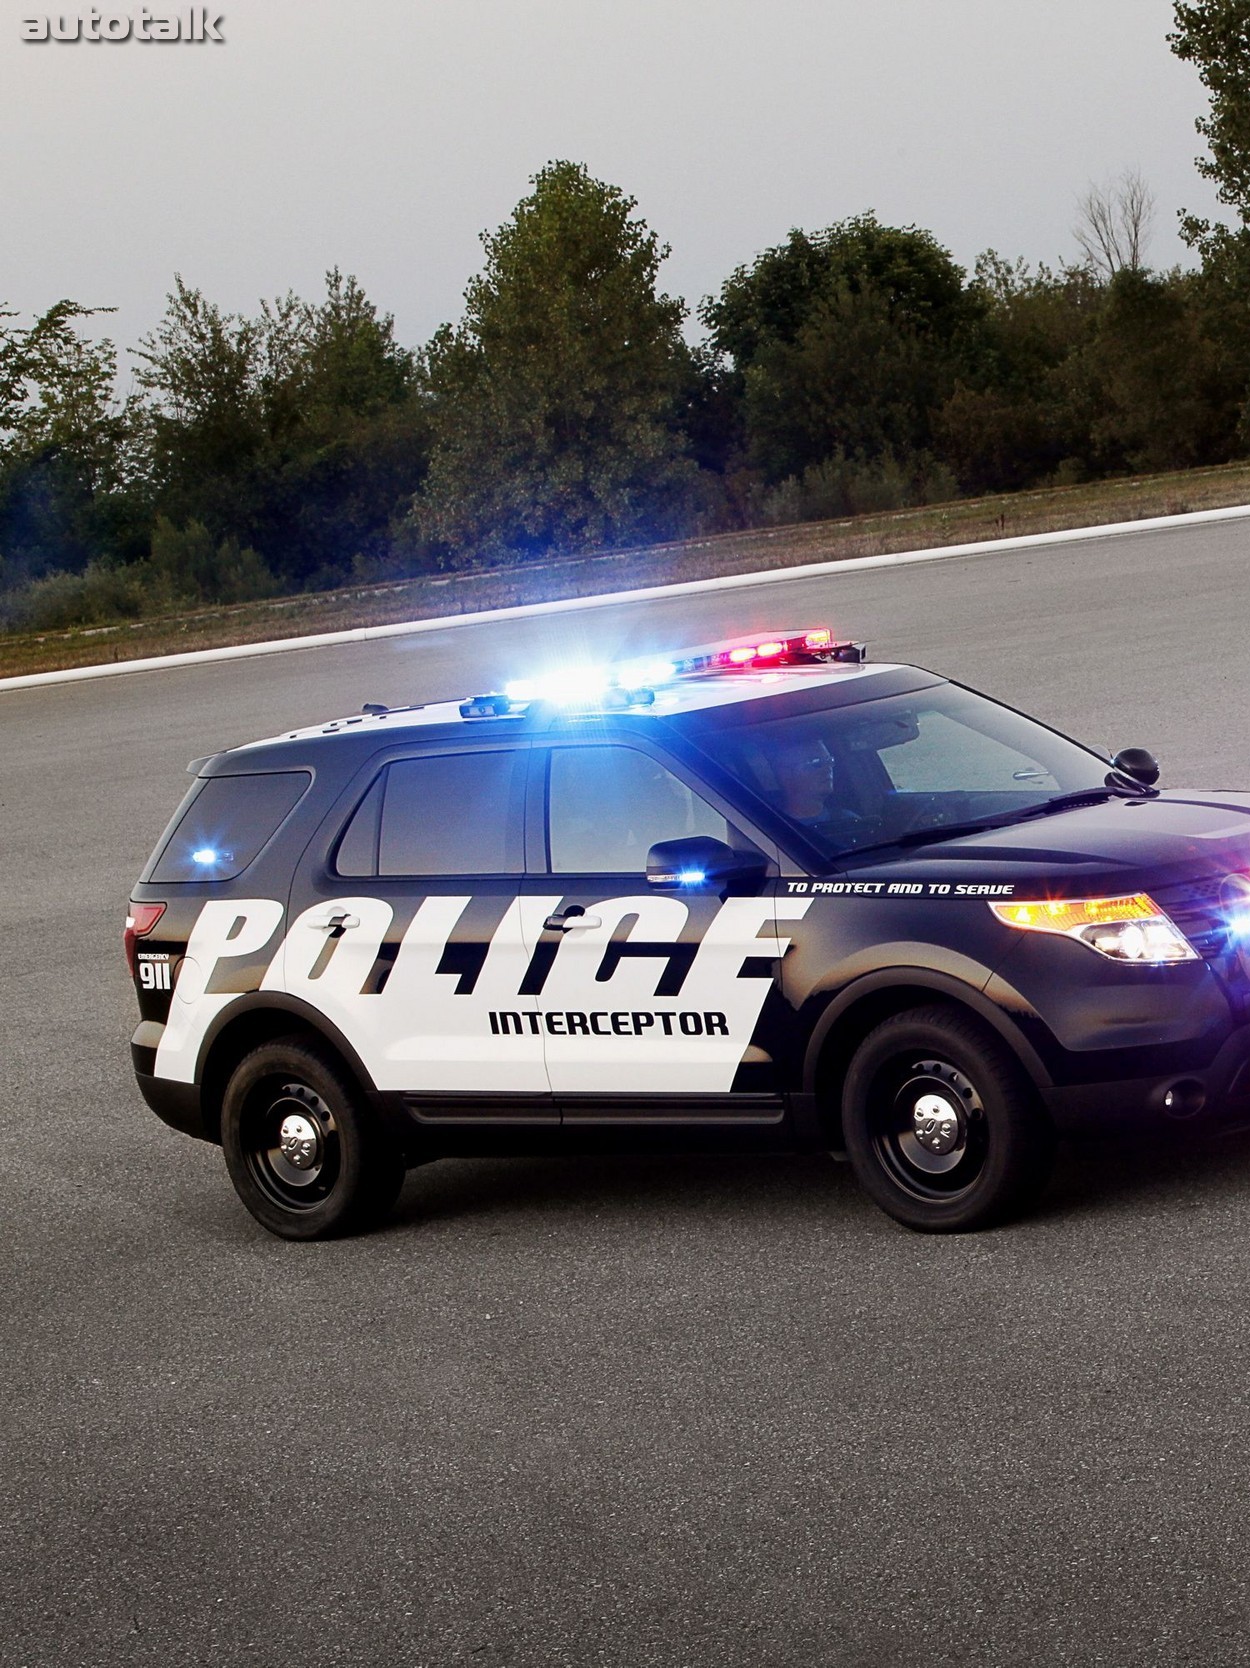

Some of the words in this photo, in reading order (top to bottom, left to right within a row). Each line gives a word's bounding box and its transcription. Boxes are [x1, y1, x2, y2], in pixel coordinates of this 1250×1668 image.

[787, 882, 809, 893] TO
[811, 882, 885, 893] PROTECT
[887, 883, 924, 894] AND
[928, 883, 951, 895] TO
[954, 884, 1015, 895] SERVE
[174, 895, 814, 997] POLICE
[139, 962, 171, 990] 911
[488, 1011, 730, 1036] INTERCEPTOR
